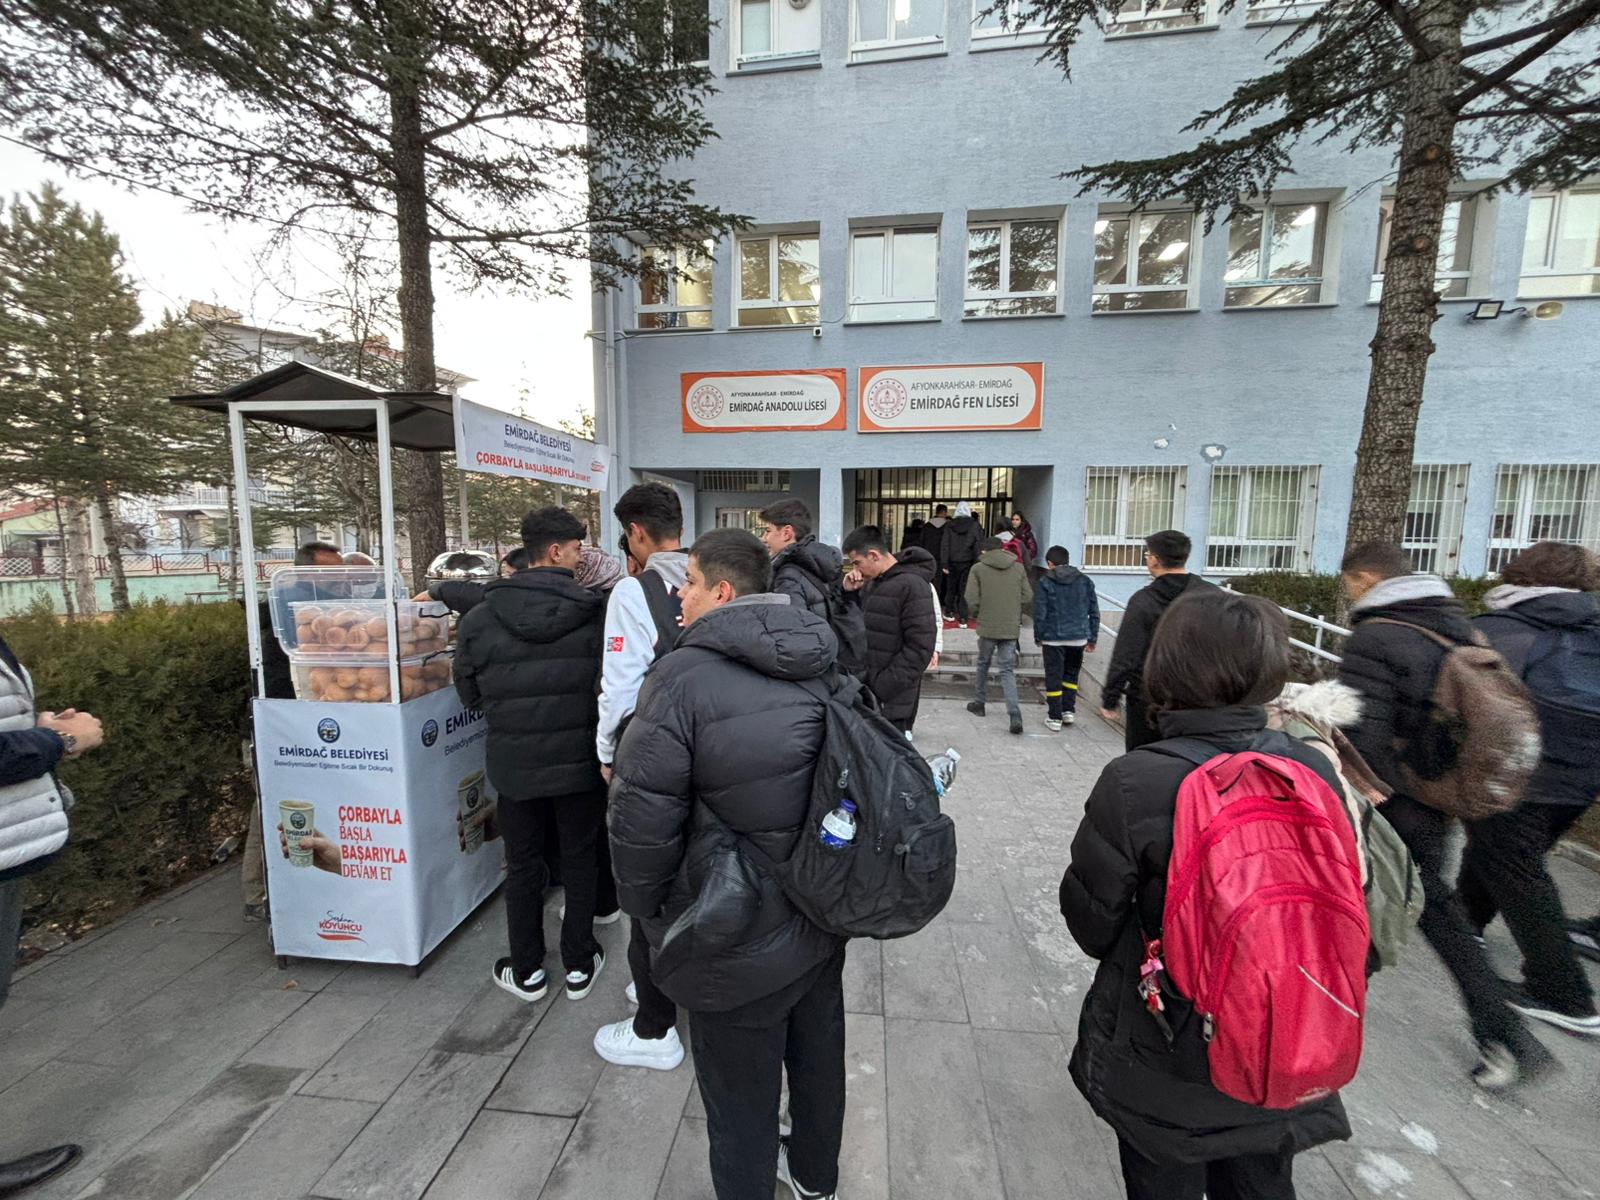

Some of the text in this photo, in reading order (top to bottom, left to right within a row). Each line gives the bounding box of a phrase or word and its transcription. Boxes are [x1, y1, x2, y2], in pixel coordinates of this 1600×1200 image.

[979, 378, 1012, 389] EMİRDAĞ
[730, 390, 777, 398] AFYONKARAHİSAR
[780, 389, 804, 397] EMİRDAĞ
[910, 393, 1019, 410] EMİRDAĞ FEN LİSESİ
[729, 398, 827, 412] EMİRDAĞ ANADOLU LİSESİ
[504, 424, 572, 452] EMİRDAĞ BELEDİYESİ
[476, 451, 524, 470] ÇORBAYLA
[445, 705, 488, 736] EMİRD
[279, 744, 389, 761] EMİRDAĞ BELEDİYESİ
[338, 805, 402, 825] ÇORBAYLA
[339, 825, 373, 844] BAŞLA
[341, 844, 408, 864] BAŞARIYLA
[342, 863, 392, 881] DEVAM ET
[319, 919, 362, 932] KOYUNCU
